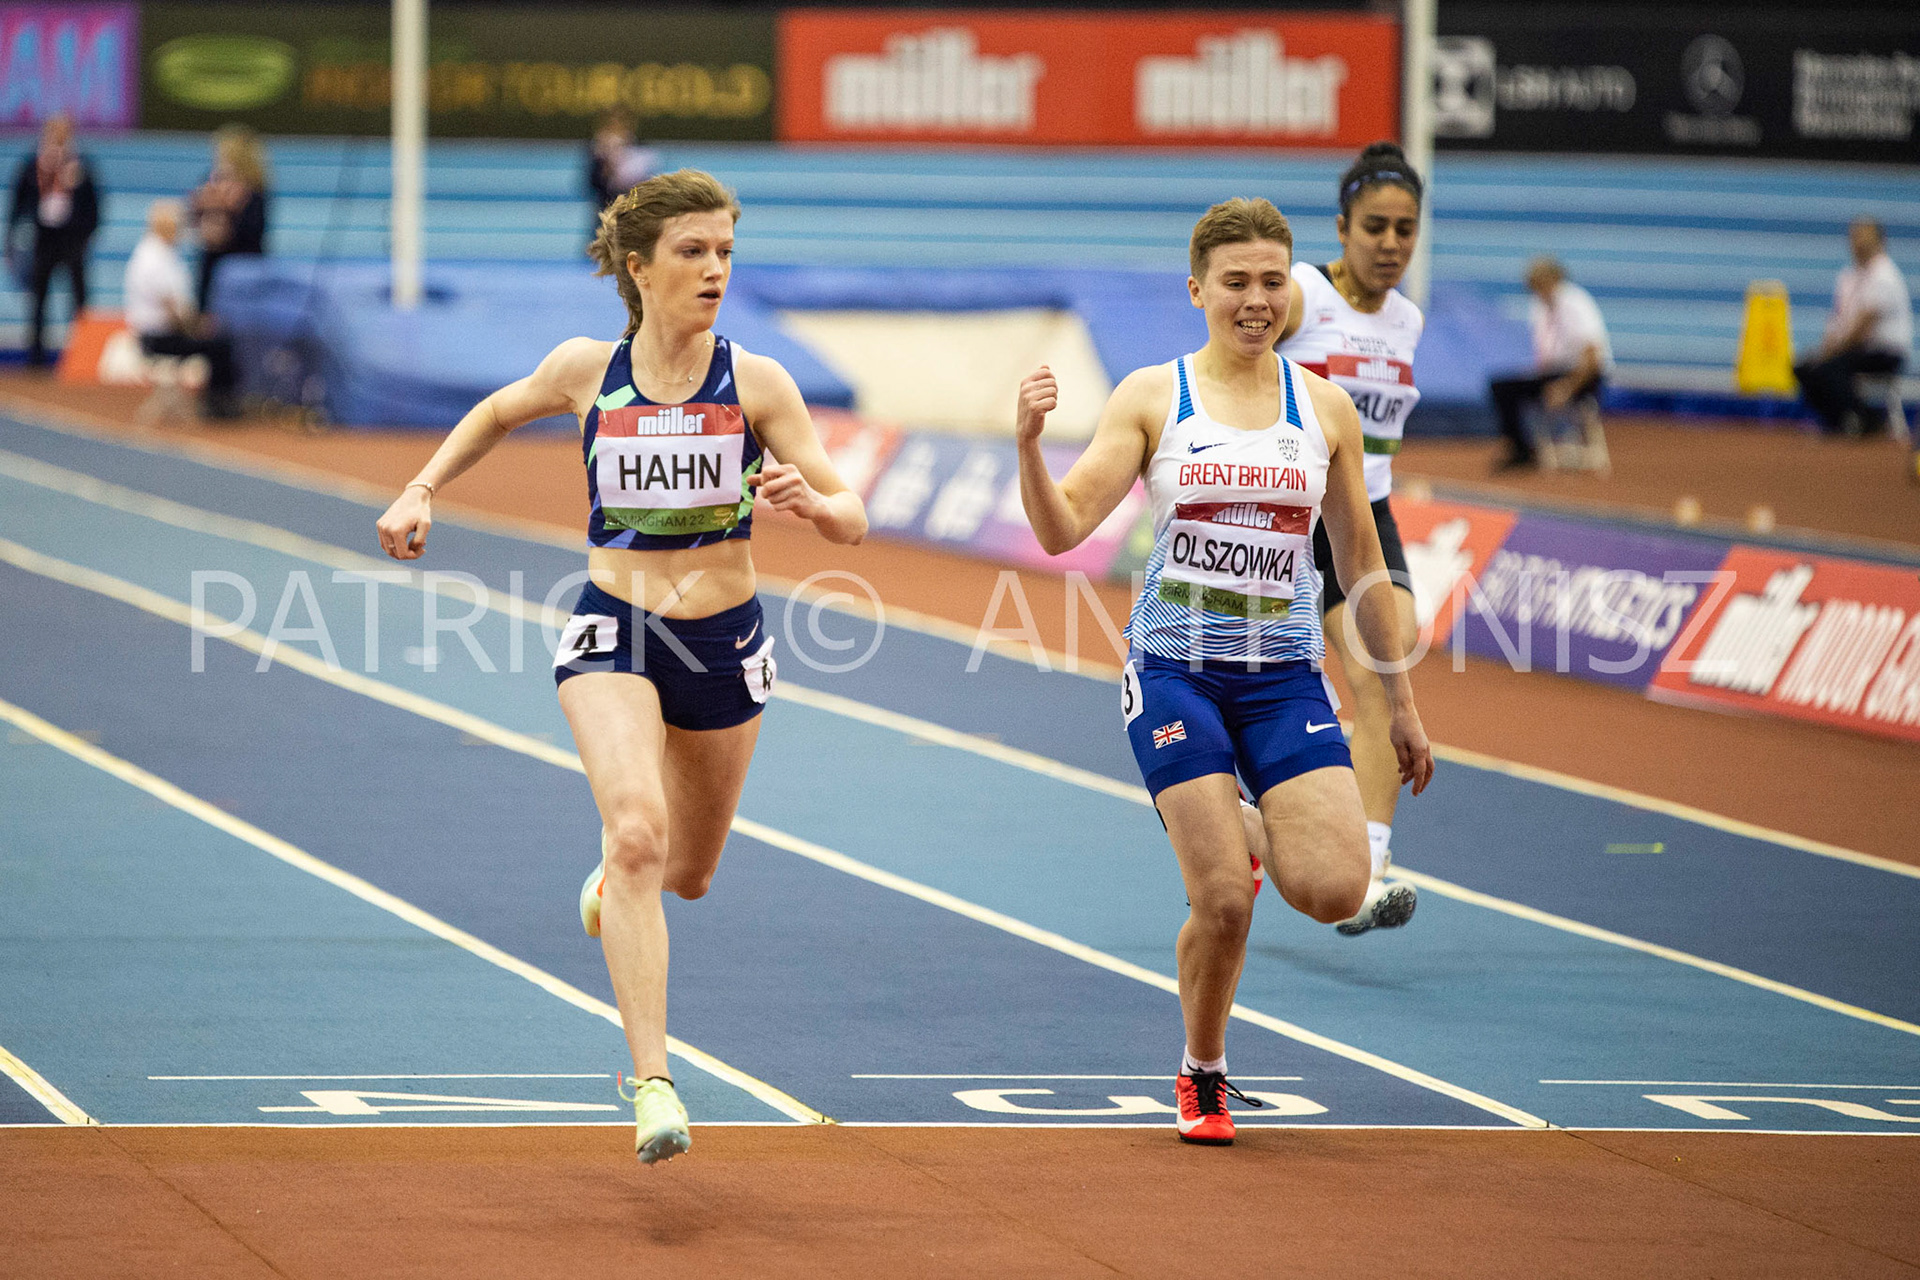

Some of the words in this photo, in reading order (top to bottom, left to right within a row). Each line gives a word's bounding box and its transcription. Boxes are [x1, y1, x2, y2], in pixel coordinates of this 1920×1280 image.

[637, 406, 705, 436] müller
[1350, 391, 1404, 424] AUR
[618, 453, 722, 491] HAHN
[1179, 463, 1236, 487] GREAT
[1238, 465, 1307, 492] BRITAIN
[689, 514, 705, 526] 22
[1211, 504, 1276, 529] müller
[1172, 532, 1295, 582] OLSZOWKA
[1163, 585, 1244, 611] BIRMINGHAM
[570, 624, 599, 654] 4
[1123, 673, 1134, 715] 3
[257, 1090, 620, 1115] 4
